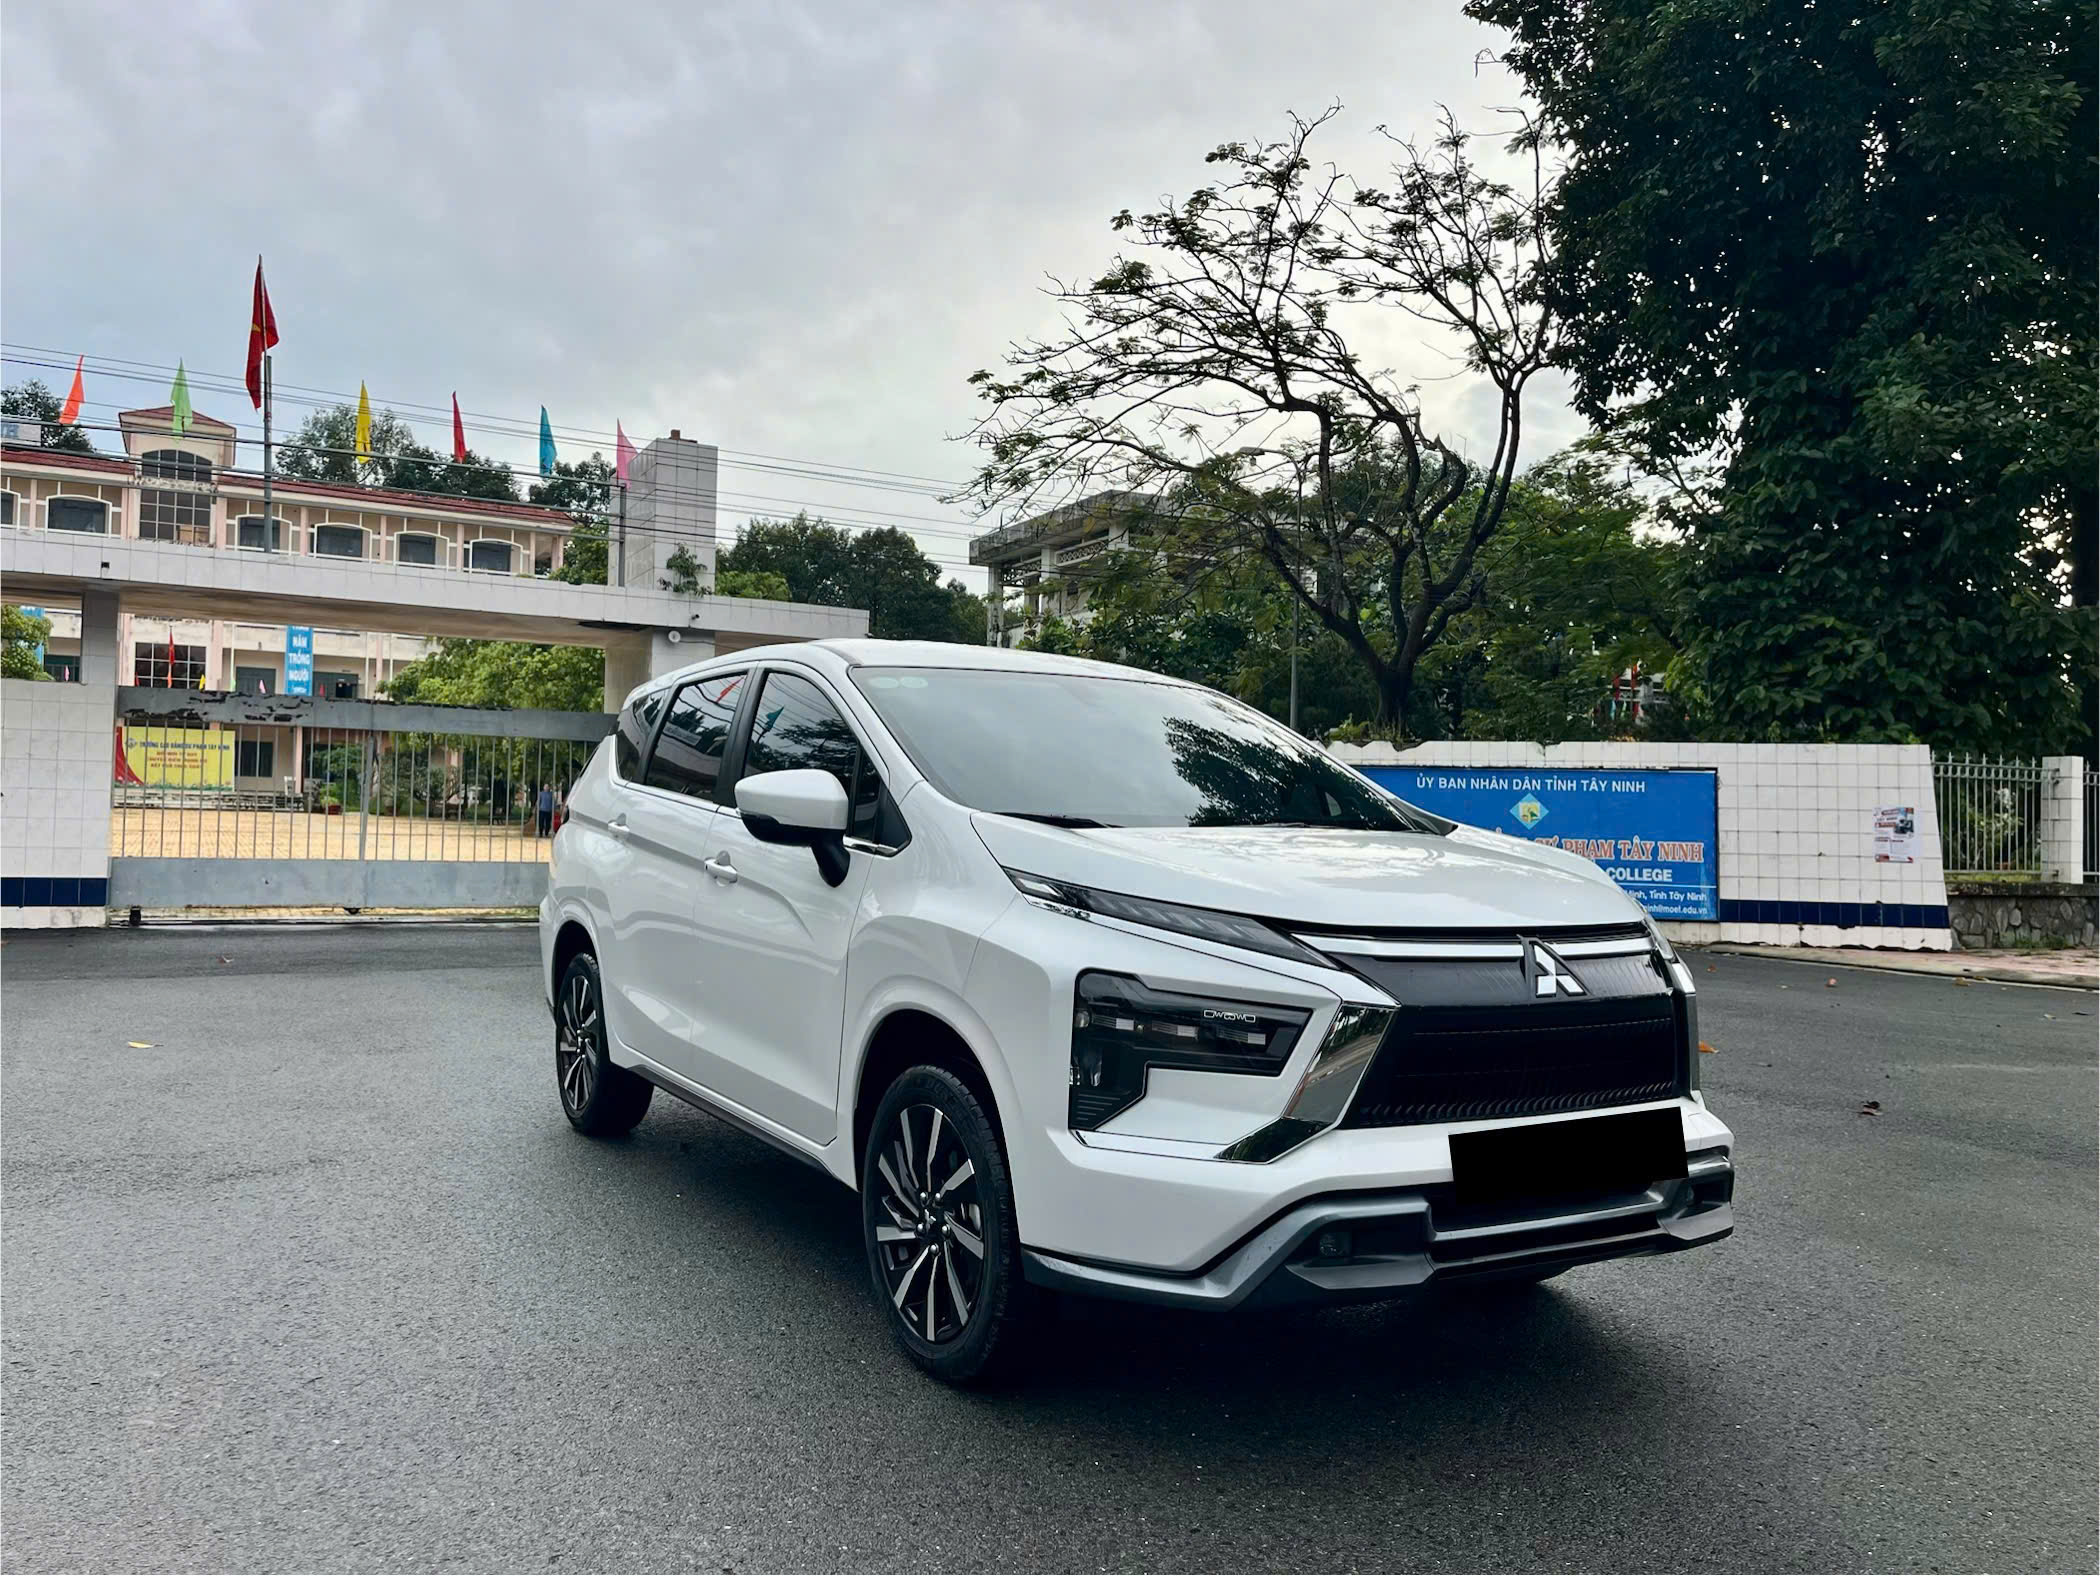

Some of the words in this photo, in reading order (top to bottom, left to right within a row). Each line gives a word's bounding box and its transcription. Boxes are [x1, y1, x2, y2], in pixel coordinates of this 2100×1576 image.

[1416, 772, 1434, 789] ỦY
[1438, 777, 1466, 790] BAN
[1470, 775, 1508, 791] NHÂN
[1512, 776, 1541, 791] DÂN
[1545, 775, 1577, 791] TỈNH
[1581, 776, 1607, 792] TÂY
[1611, 780, 1645, 793] NINH
[1618, 835, 1655, 861] TÂY
[1657, 840, 1704, 862] NINH
[1605, 867, 1673, 882] COLLEGE
[1687, 891, 1707, 901] Ninh
